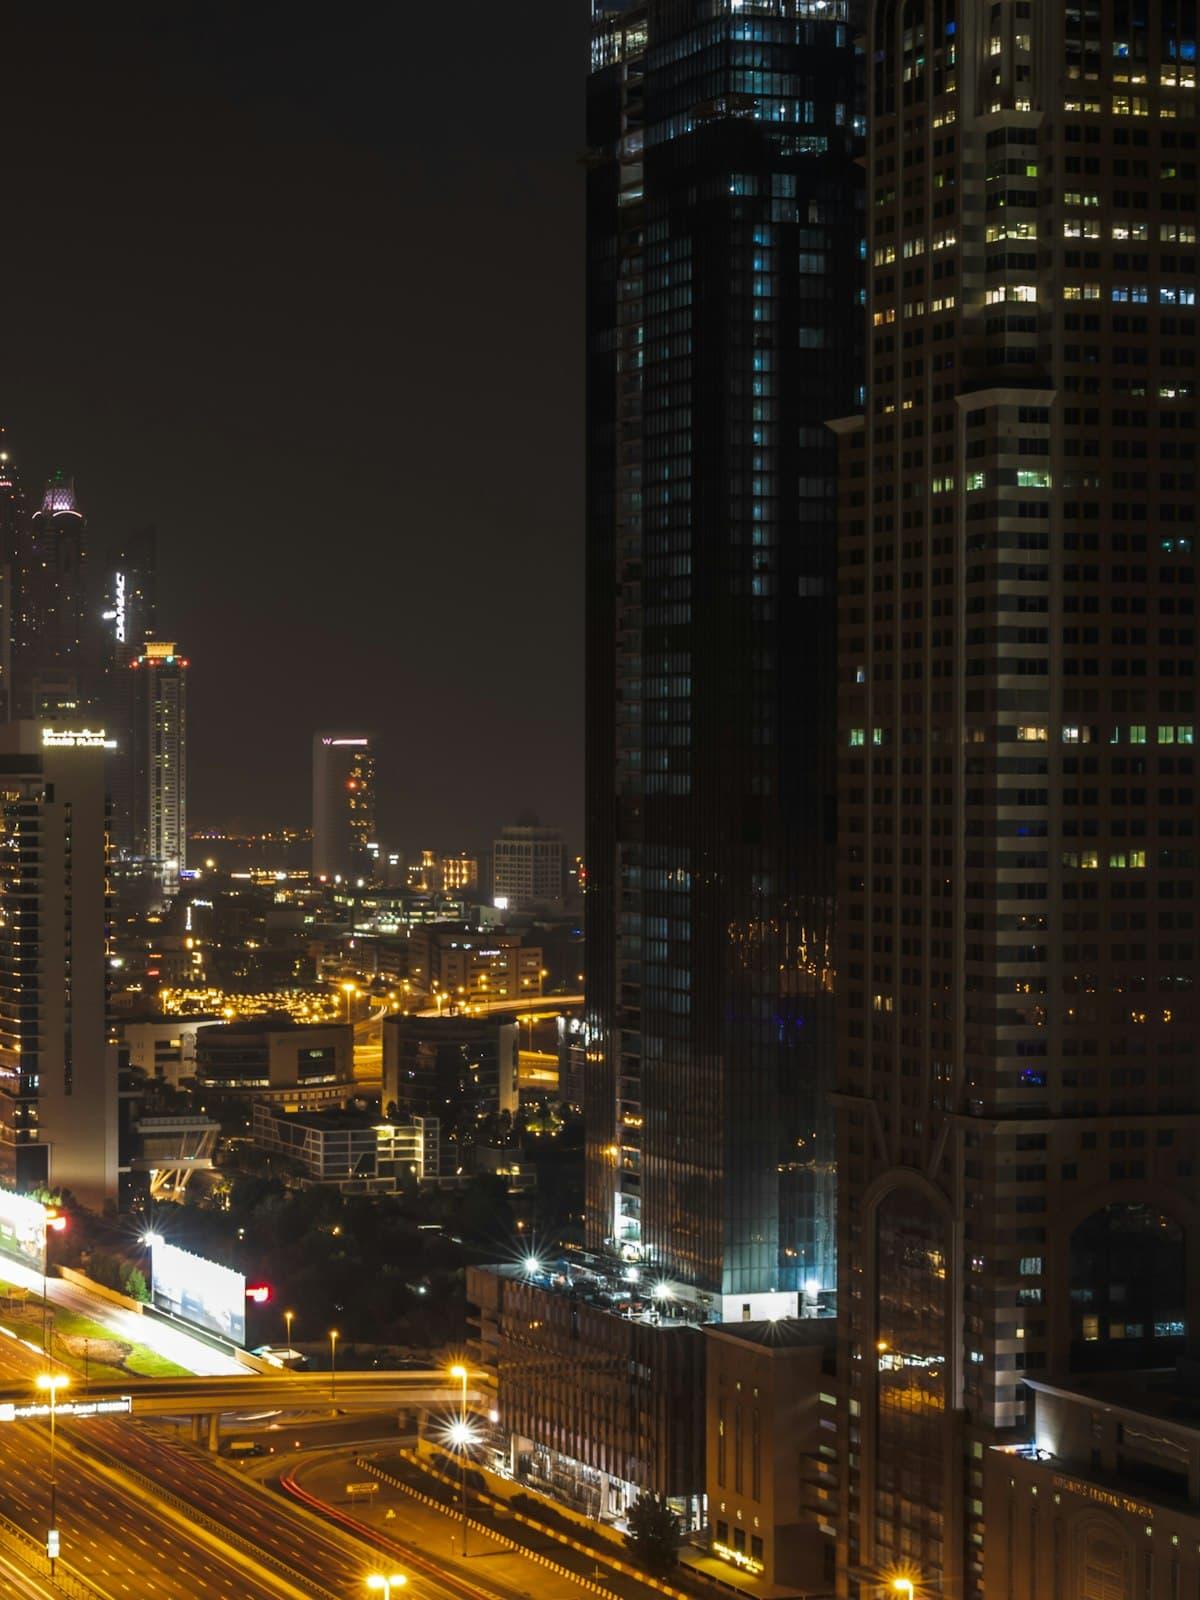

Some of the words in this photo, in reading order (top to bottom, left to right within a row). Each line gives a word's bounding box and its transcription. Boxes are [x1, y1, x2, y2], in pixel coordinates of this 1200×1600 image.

[115, 572, 125, 642] DAMAC
[42, 736, 76, 747] GRAND
[76, 737, 105, 747] PLAZA
